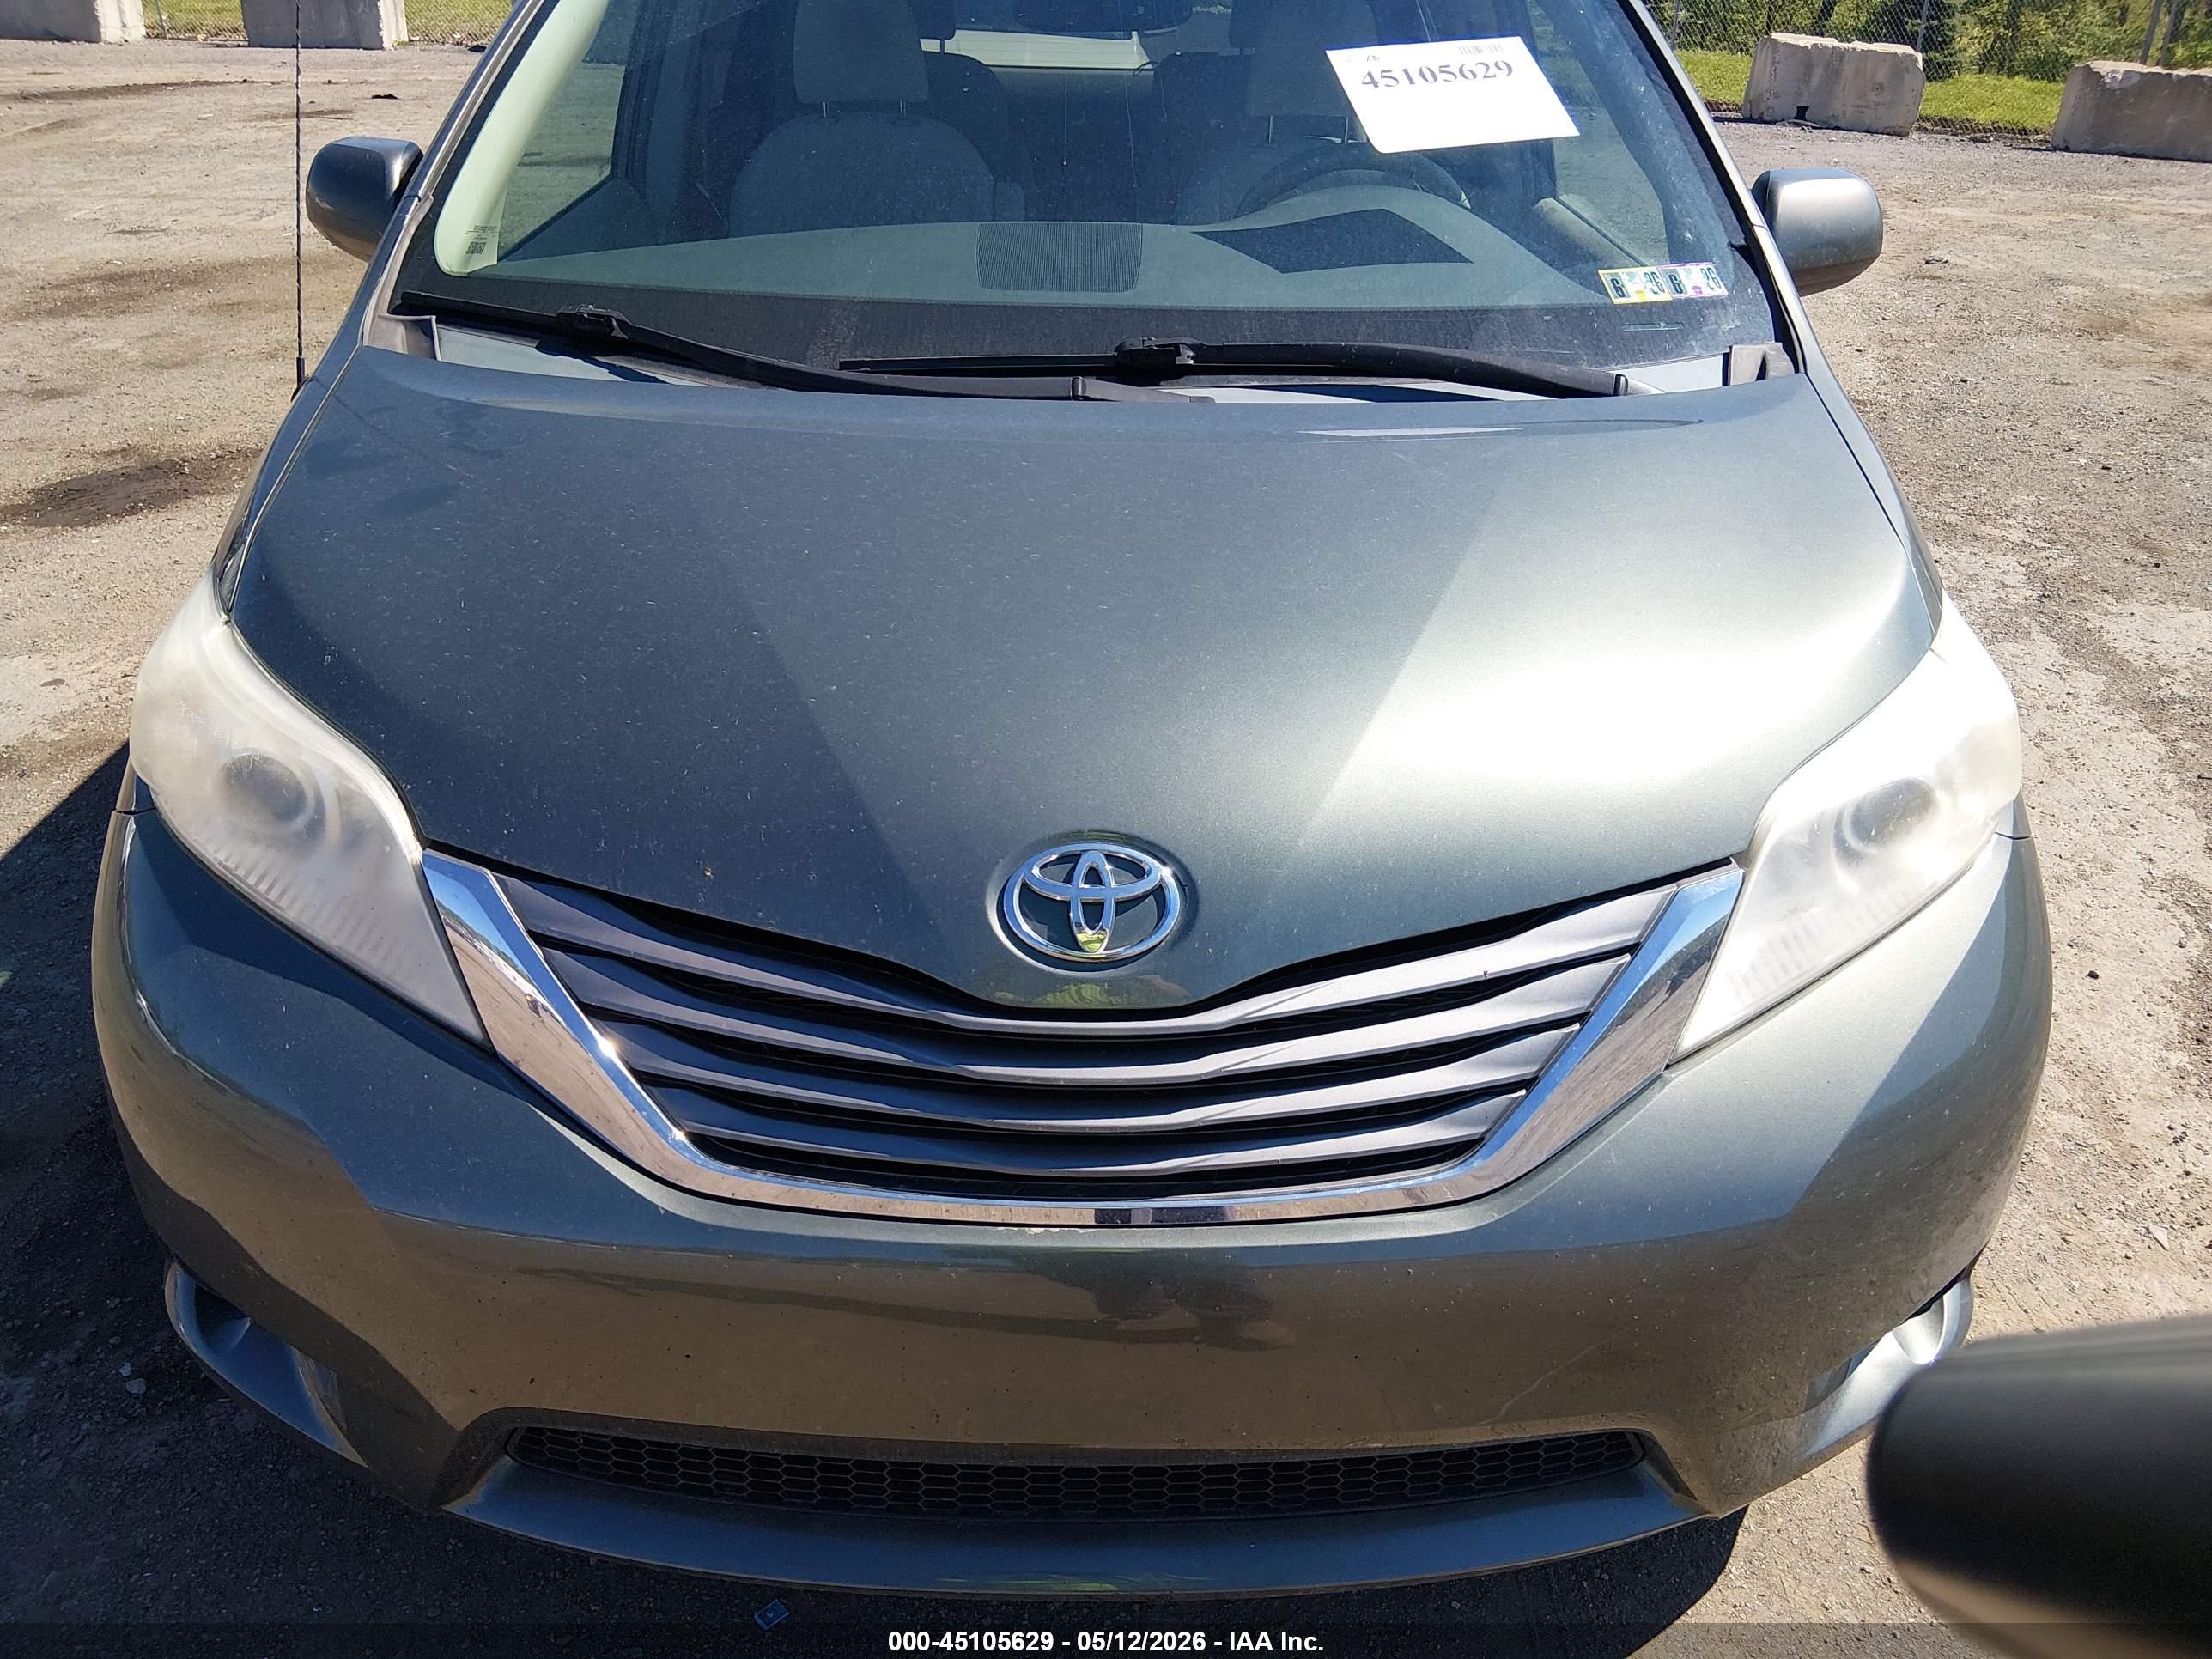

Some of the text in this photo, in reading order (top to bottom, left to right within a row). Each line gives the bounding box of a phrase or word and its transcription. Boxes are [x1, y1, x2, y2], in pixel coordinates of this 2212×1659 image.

[1361, 59, 1513, 88] 45105629
[1611, 277, 1626, 298] 6
[1668, 274, 1684, 295] 6
[1700, 268, 1722, 290] 26
